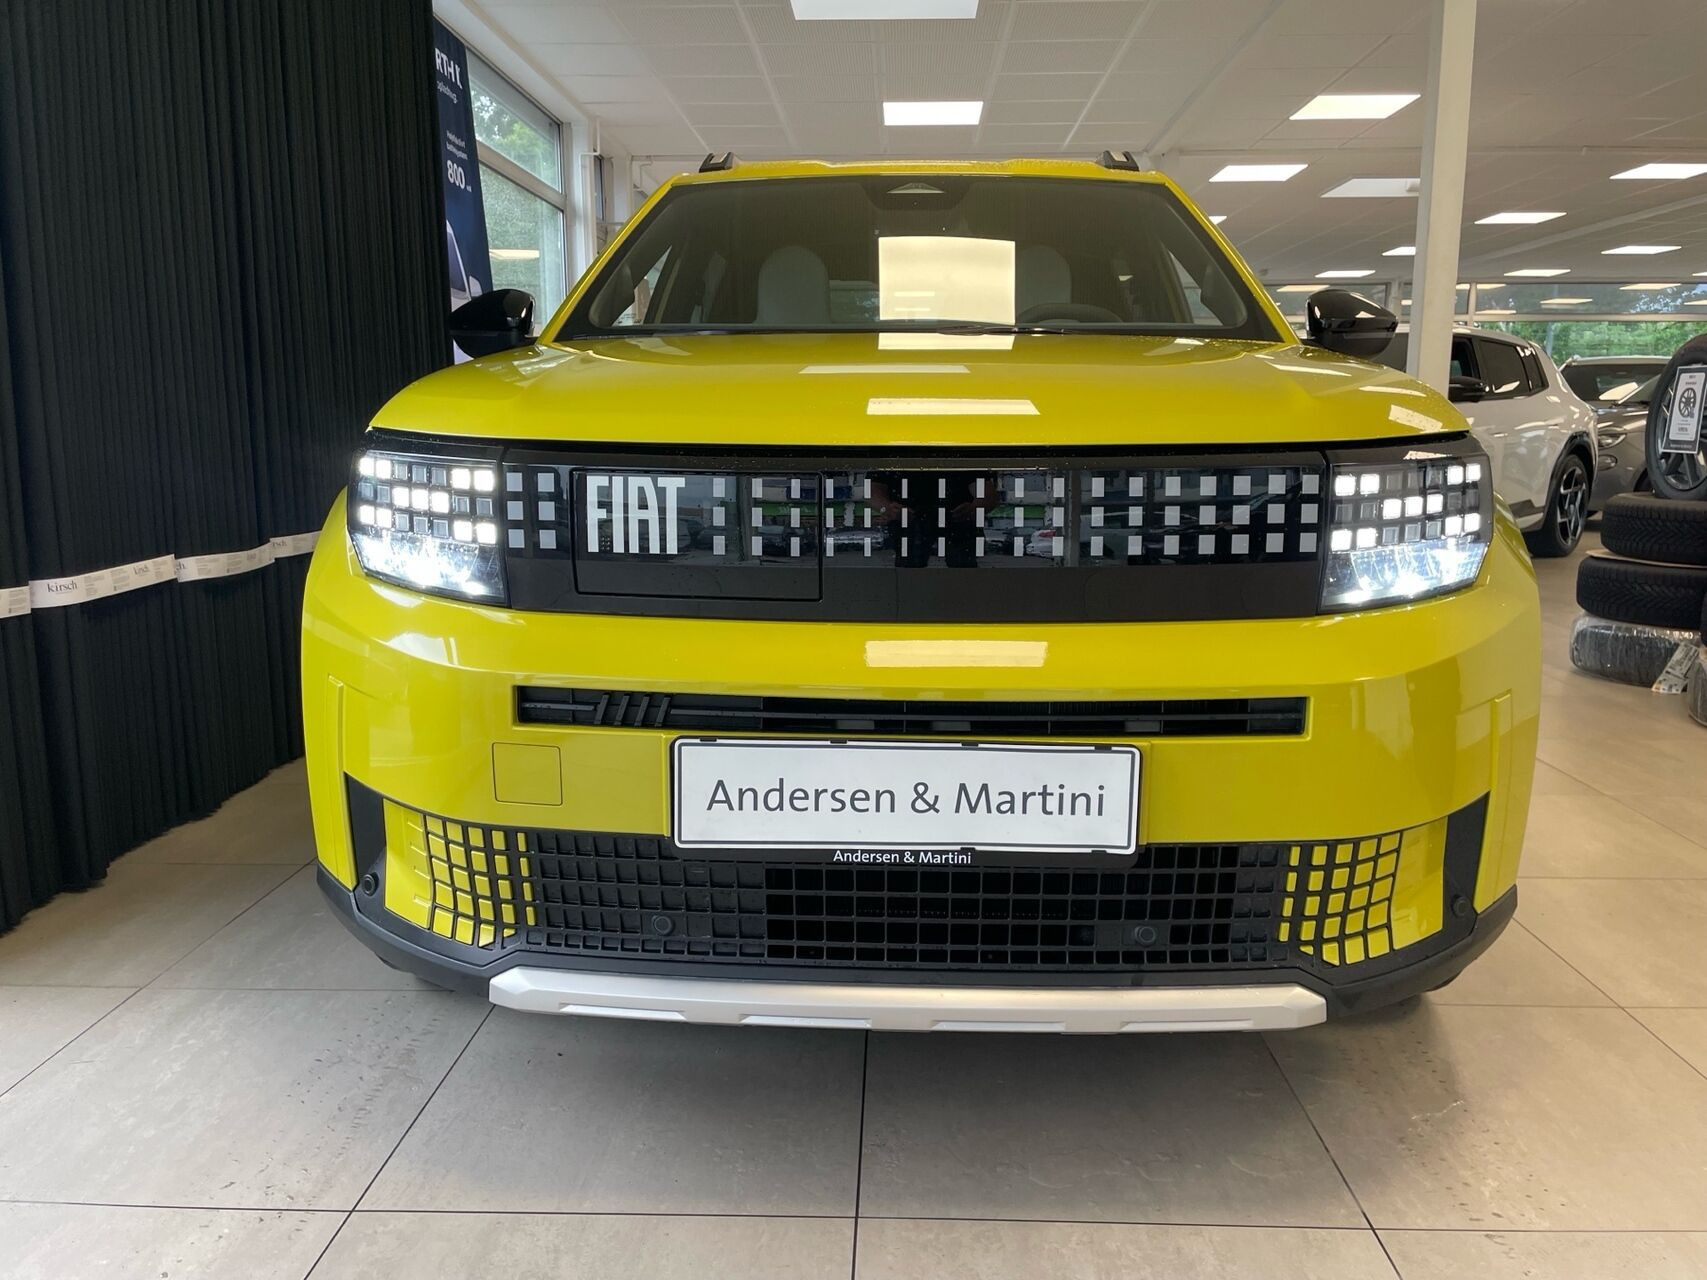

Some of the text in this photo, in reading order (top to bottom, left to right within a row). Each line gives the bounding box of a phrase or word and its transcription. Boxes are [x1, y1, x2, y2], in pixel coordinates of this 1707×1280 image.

[447, 160, 465, 190] 800
[586, 475, 686, 555] FIAT
[47, 580, 78, 592] kirsch
[706, 777, 1105, 817] Andersen & Martini
[833, 849, 972, 864] Andersen & Martini
